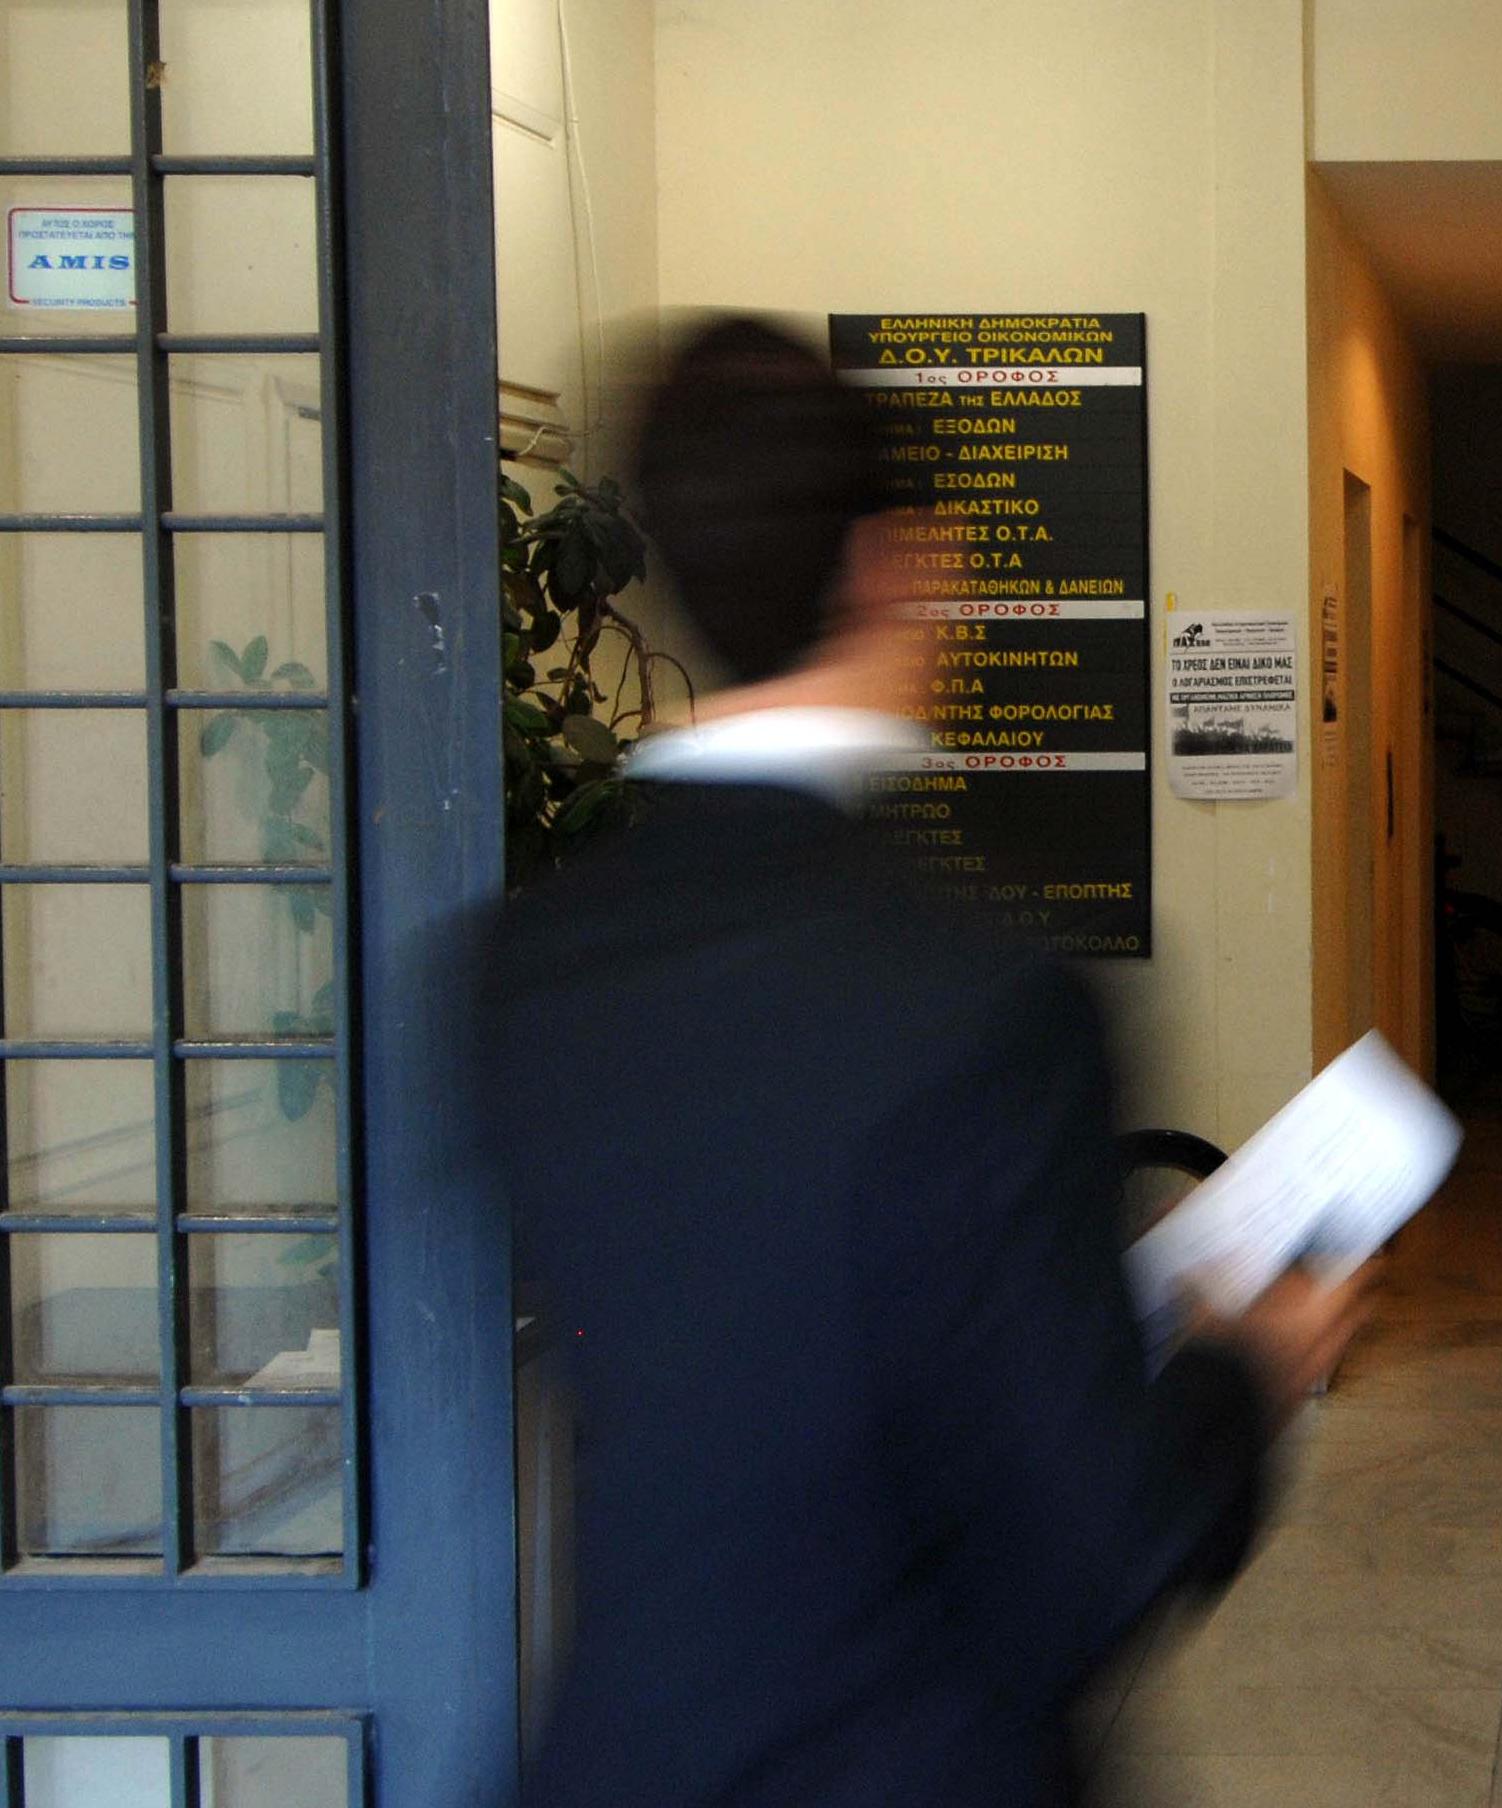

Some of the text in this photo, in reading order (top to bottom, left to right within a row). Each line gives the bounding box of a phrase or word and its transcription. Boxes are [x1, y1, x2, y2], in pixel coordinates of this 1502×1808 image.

[28, 255, 130, 270] AMIS
[880, 317, 1101, 330] ΕΛΛΗΝΙΚΗ ΔΗΜΟΚΡΑΤΙΑ
[868, 331, 1113, 344] ΥΠΟΥΡΓΕΙΟ ΟΙΚΟΝΟΜΙΚΩΝ
[878, 348, 1104, 365] Δ.Ο.Υ. ΤΡΙΚΑΛΩΝ
[957, 371, 1060, 383] ΟΡΟΦΟΣ
[990, 390, 1082, 406] ΕΛΛΑΔΟΣ
[933, 419, 1016, 434] ΕΞΟΔΩΝ
[877, 446, 941, 461] ΑΜΕΙΟ
[958, 446, 1069, 461] ΔΙΑΧΕΙΡΙΣΗ
[933, 473, 1016, 488] ΕΣΟΔΩΝ
[934, 500, 1040, 515] ΔΙΚΑΣΤΙΚΟ
[996, 526, 1053, 541] Ο.Τ.Α.
[1059, 580, 1124, 595] ΔΑΝΕΙΩΝ
[959, 603, 1061, 616] ΟΡΟΦΟΣ
[937, 651, 1079, 667] ΑΥΤΟΚΙΝΗΤΩΝ
[1209, 657, 1226, 670] ΔΕΝ
[1228, 657, 1250, 670] ΕΙΝΑΙ
[1274, 656, 1293, 669] ΜΑΣ
[989, 704, 1114, 720] ΦΟΡΟΛΟΓΙΑΣ
[931, 731, 1044, 747] ΚΕΦΑΛΑΙΟΥ
[965, 755, 1067, 768] ΟΡΟΦΟΣ
[1044, 884, 1132, 899] ΕΠΟΠΤΗΣ
